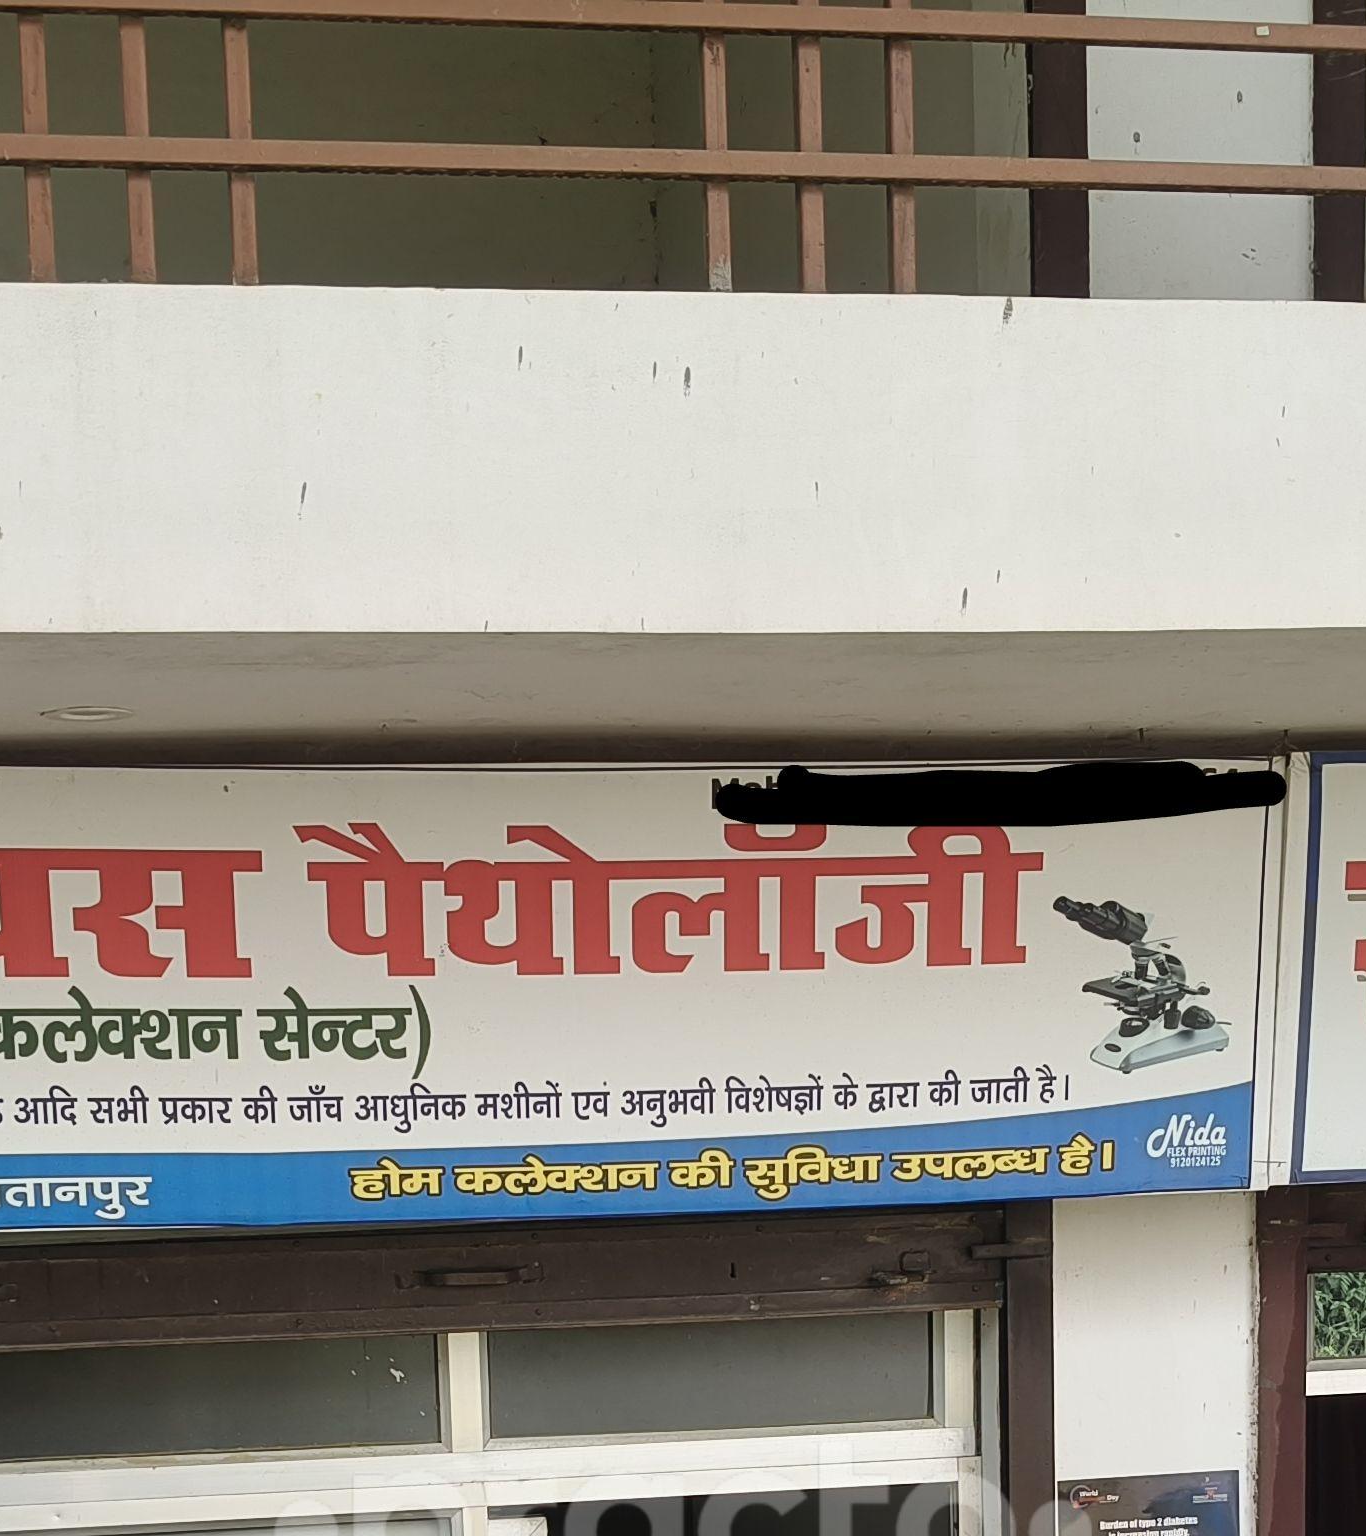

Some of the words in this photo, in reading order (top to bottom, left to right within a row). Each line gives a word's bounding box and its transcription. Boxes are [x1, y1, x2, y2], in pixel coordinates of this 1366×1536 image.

[292, 822, 1044, 977] पैथोलॉजी
[257, 984, 432, 1079] सेन्टर)
[14, 1085, 77, 1125] आदि
[88, 1085, 148, 1125] सभी
[159, 1097, 232, 1126] प्रकार
[242, 1085, 277, 1124] की
[287, 1084, 343, 1123] जाँच
[355, 1083, 466, 1133] आधुनिक
[476, 1081, 562, 1120] मशीनों
[572, 1080, 611, 1121] एवं
[620, 1077, 715, 1127] अनुभवी
[725, 1073, 824, 1116] विशेषज्ञों
[833, 1073, 858, 1110] के
[866, 1081, 920, 1113] द्वारा
[928, 1069, 961, 1106] की
[970, 1066, 1030, 1105] जाती
[1147, 1113, 1226, 1158] Nida
[1167, 1147, 1186, 1157] FLEX
[1188, 1145, 1227, 1157] PRINTING
[349, 1156, 443, 1201] होम
[453, 1154, 659, 1196] कलेक्शन
[668, 1147, 735, 1192] की
[745, 1145, 883, 1200] सुविधा
[890, 1145, 1050, 1183] उपलब्ध
[1157, 1517, 1163, 1527] 2
